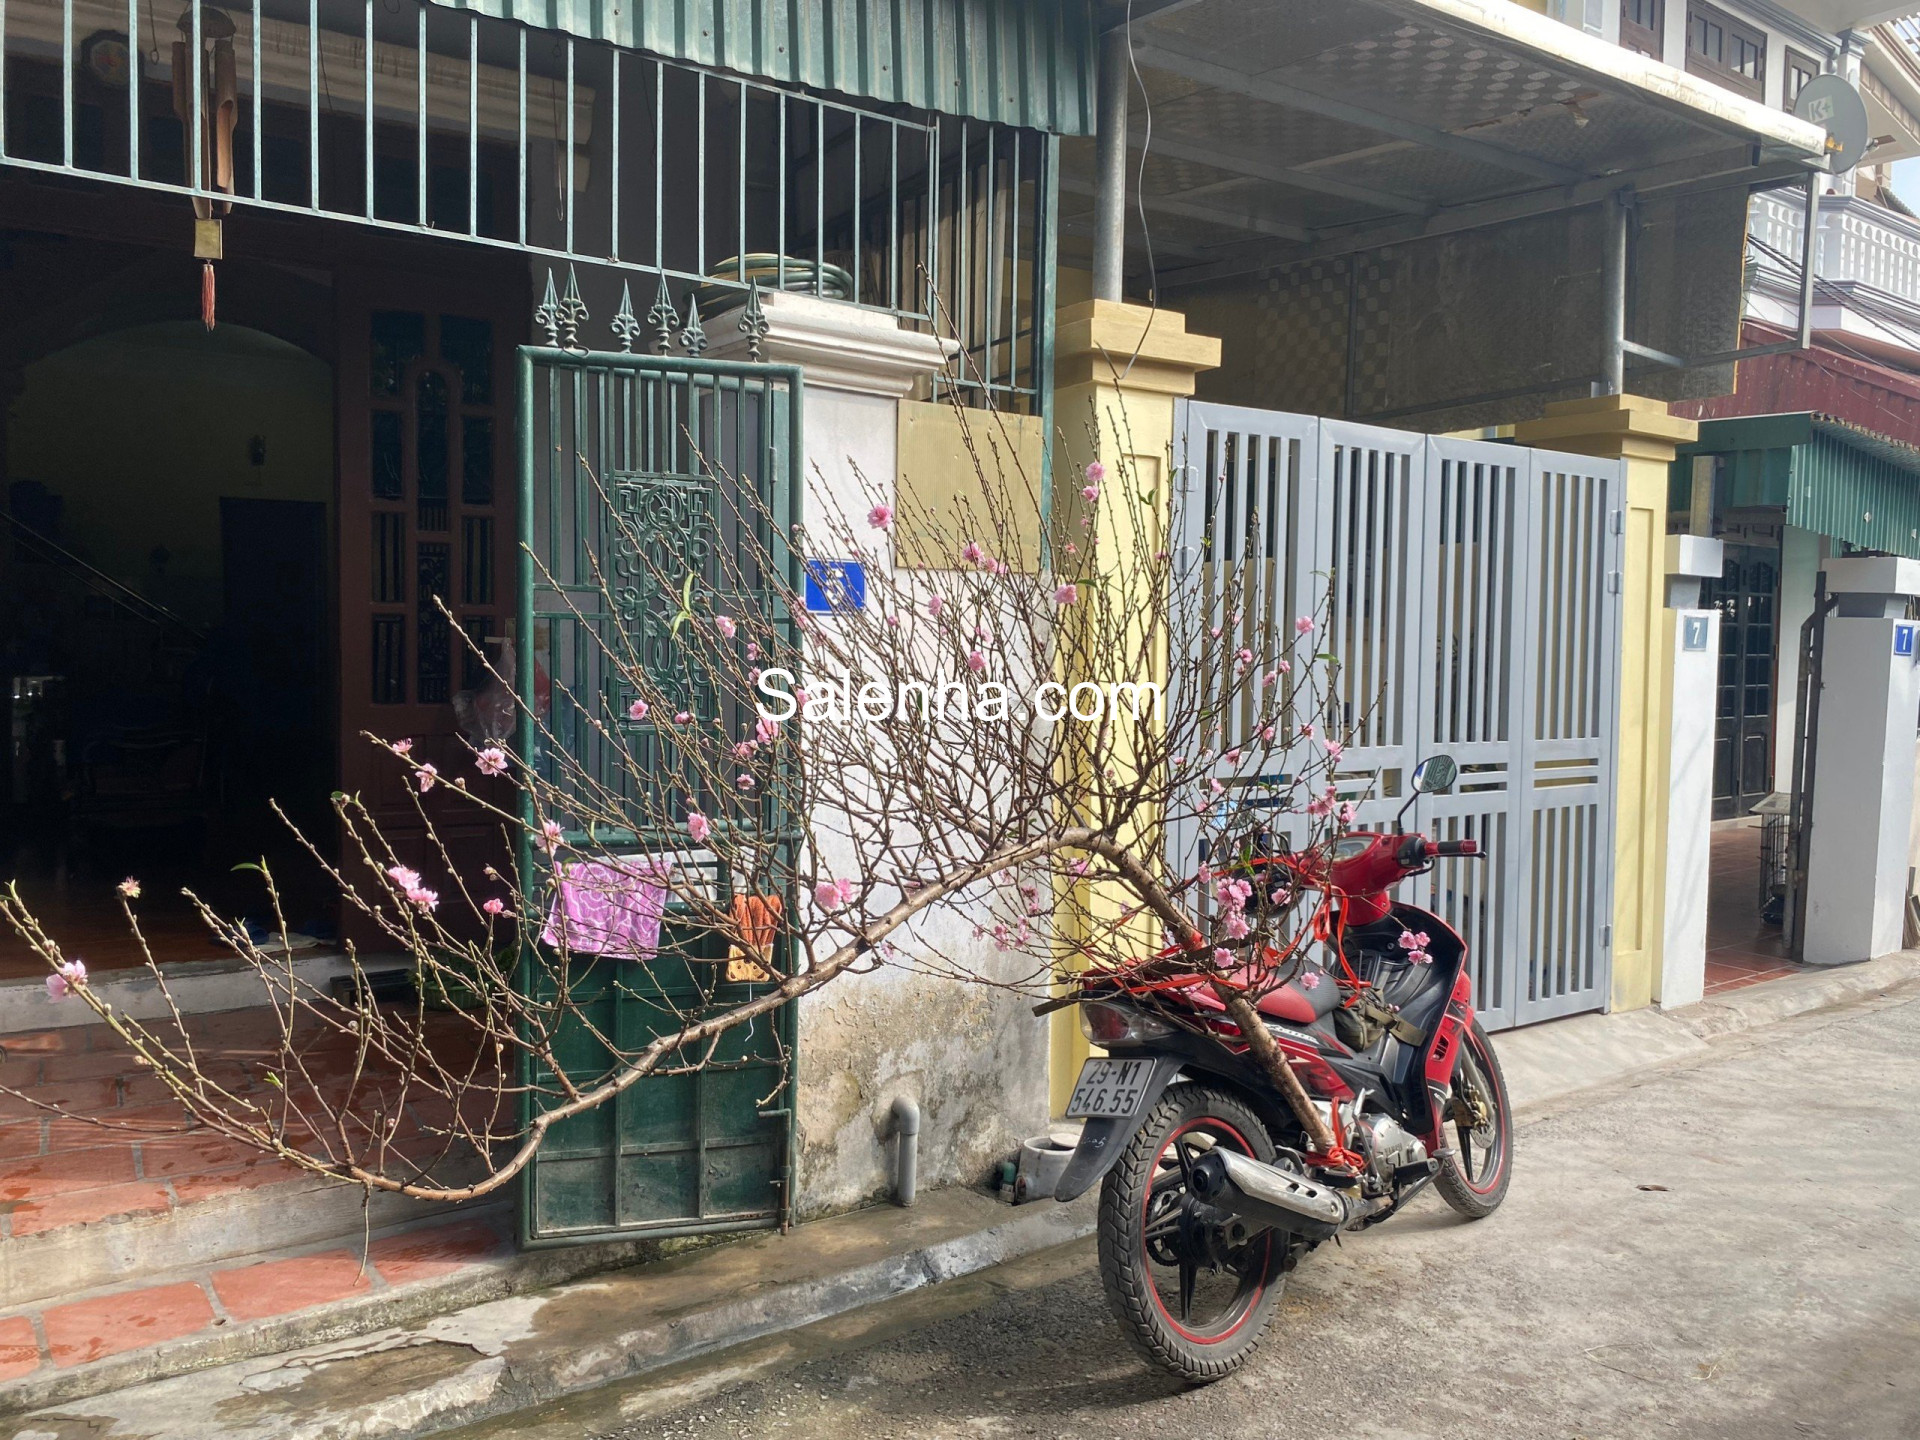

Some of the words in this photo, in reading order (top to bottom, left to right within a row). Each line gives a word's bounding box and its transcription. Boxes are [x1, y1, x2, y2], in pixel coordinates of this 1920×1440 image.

[1693, 622, 1701, 645] 7
[1902, 629, 1909, 651] 7
[1087, 1061, 1142, 1085] 29-N1
[1072, 1088, 1138, 1114] 546.55
